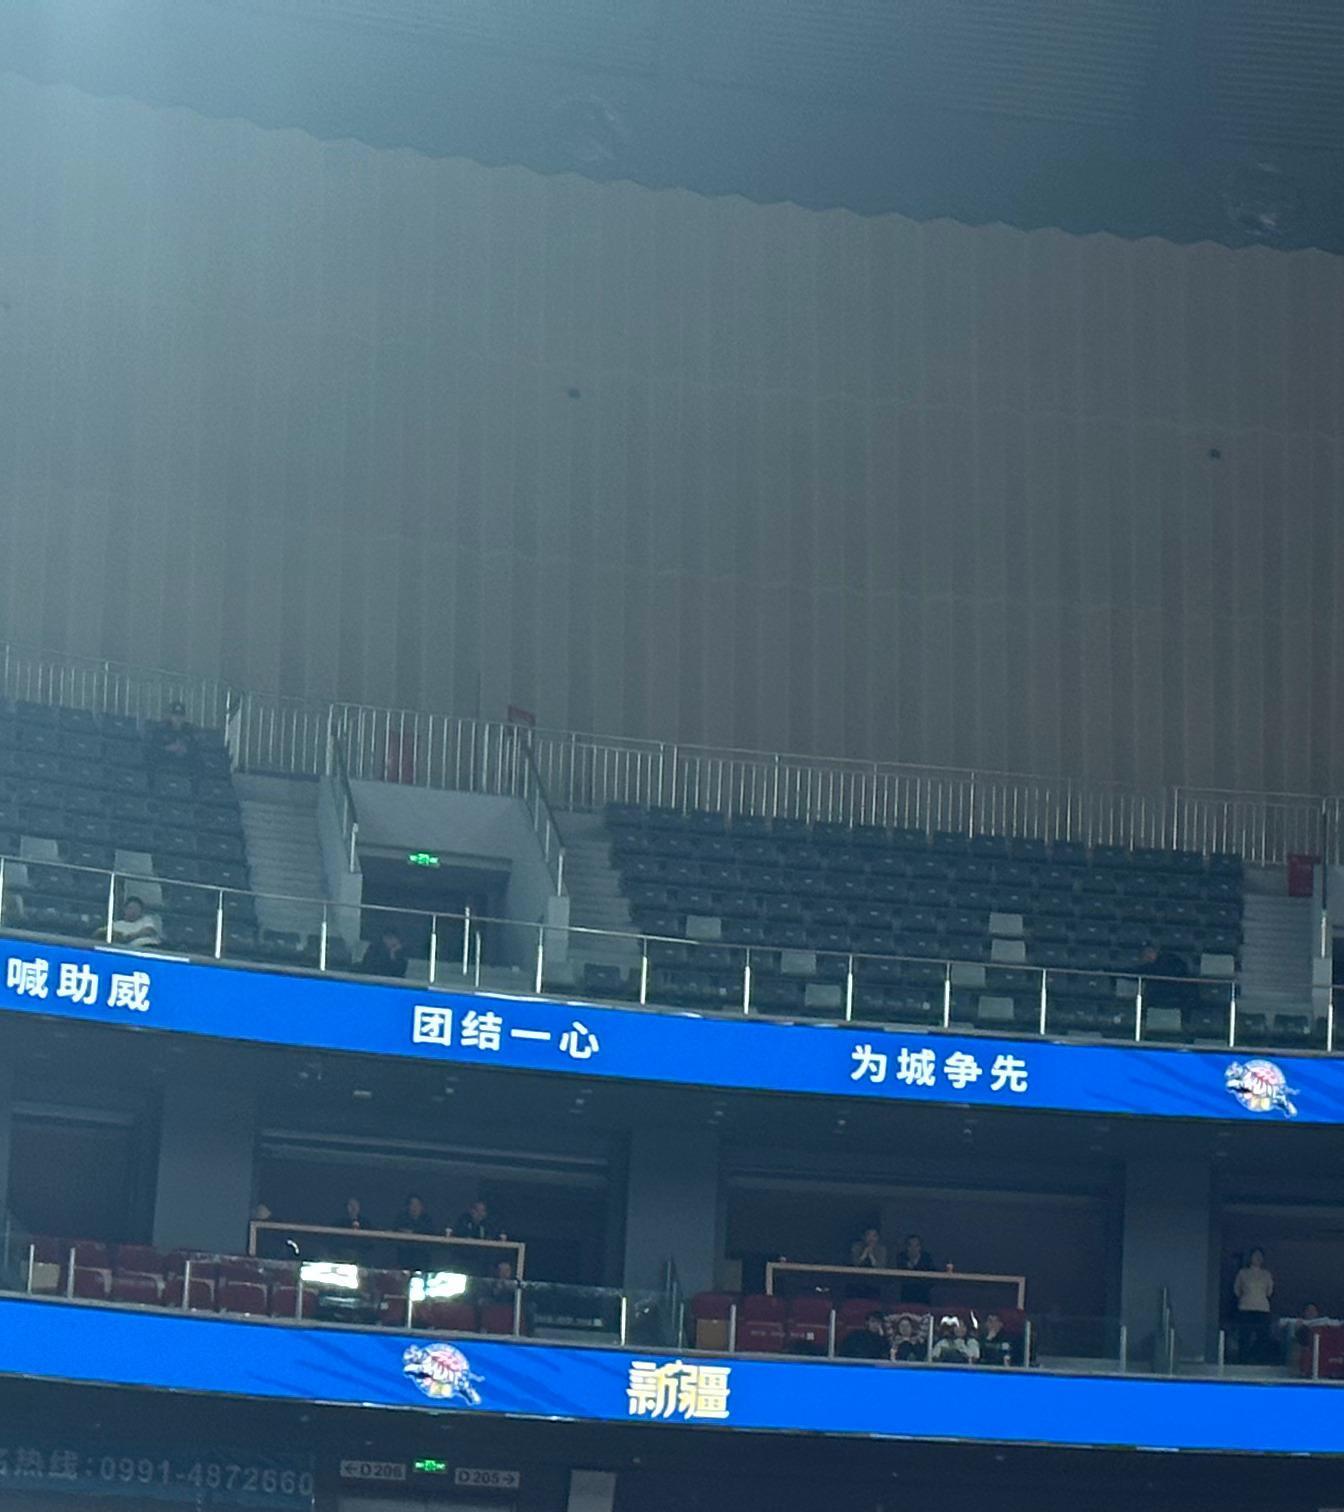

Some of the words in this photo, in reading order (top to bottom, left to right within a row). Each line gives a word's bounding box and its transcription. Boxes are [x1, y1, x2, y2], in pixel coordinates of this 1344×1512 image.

[7, 957, 150, 1011] 喊助威
[413, 1005, 599, 1058] 团结一心
[851, 1045, 1028, 1092] 为城争先
[627, 1360, 731, 1419] 新疆
